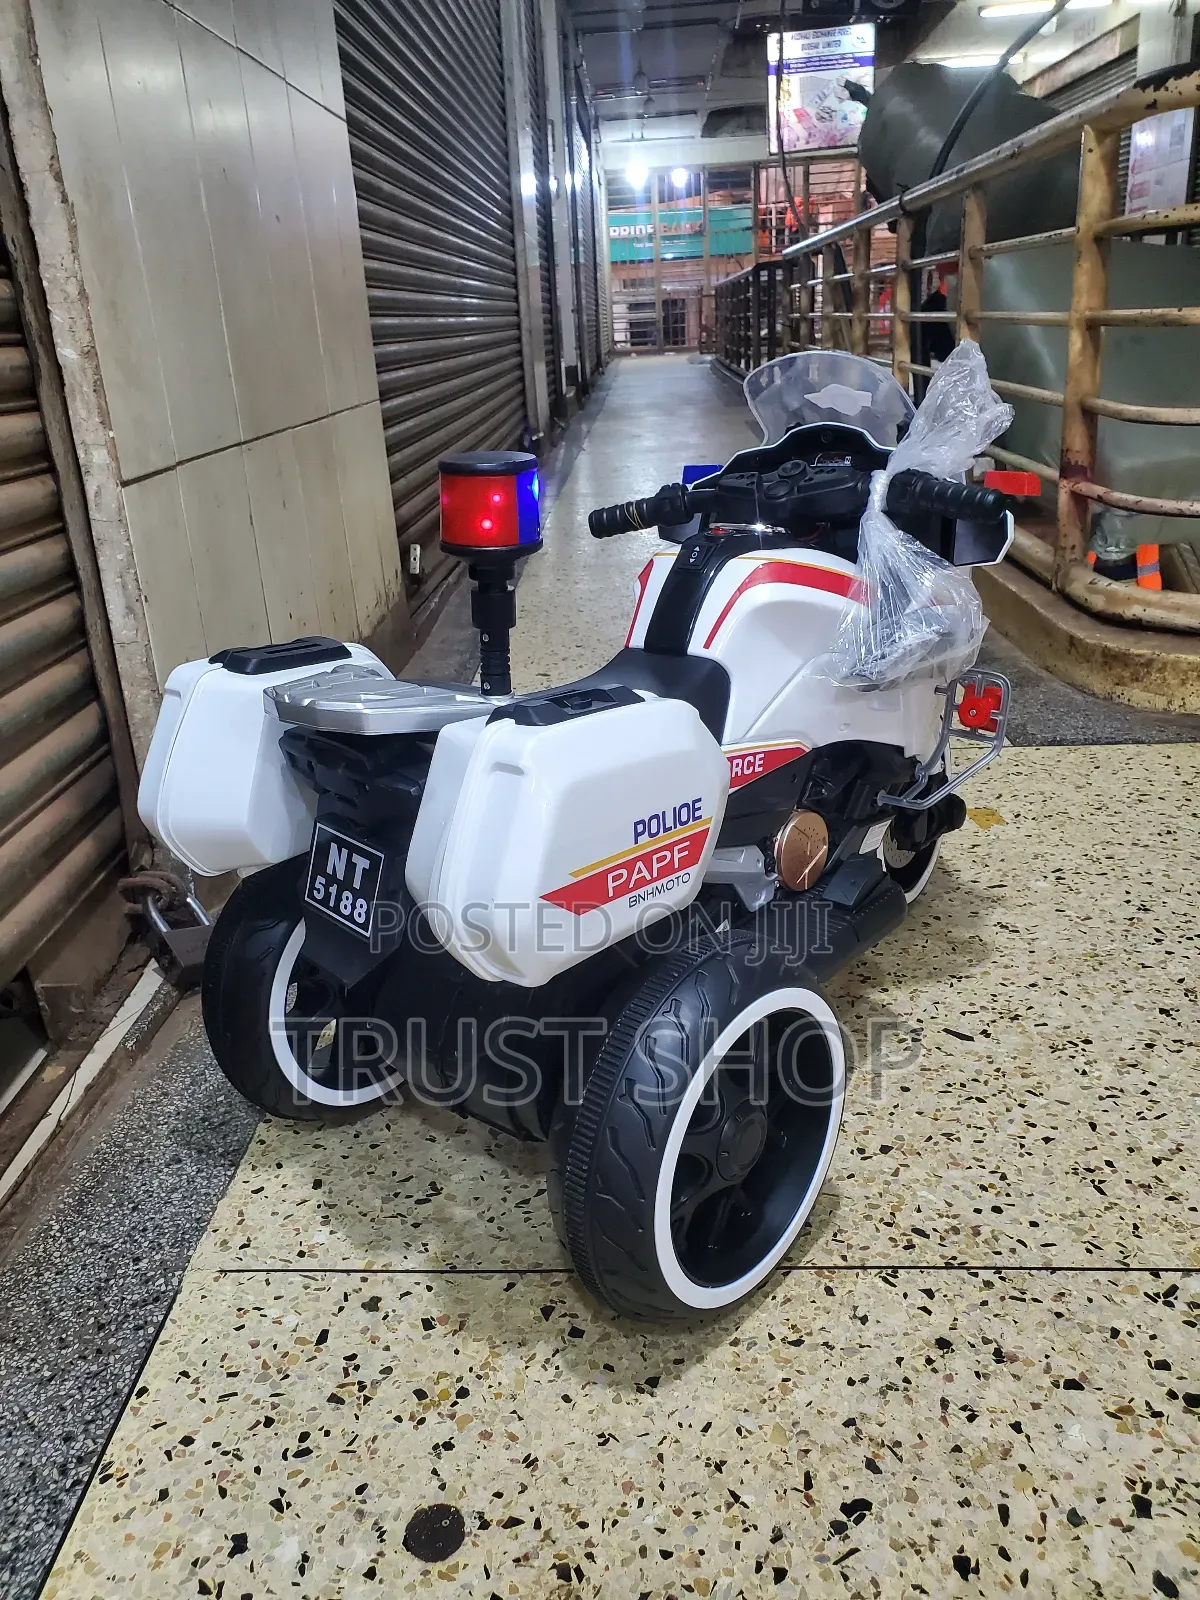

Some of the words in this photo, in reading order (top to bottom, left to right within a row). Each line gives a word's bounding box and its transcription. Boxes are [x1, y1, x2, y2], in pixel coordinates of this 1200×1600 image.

[633, 797, 703, 845] POLIOE
[326, 841, 371, 890] NT
[607, 840, 691, 898] PAPF
[313, 875, 368, 924] 5188
[628, 872, 691, 909] BNHMOTO
